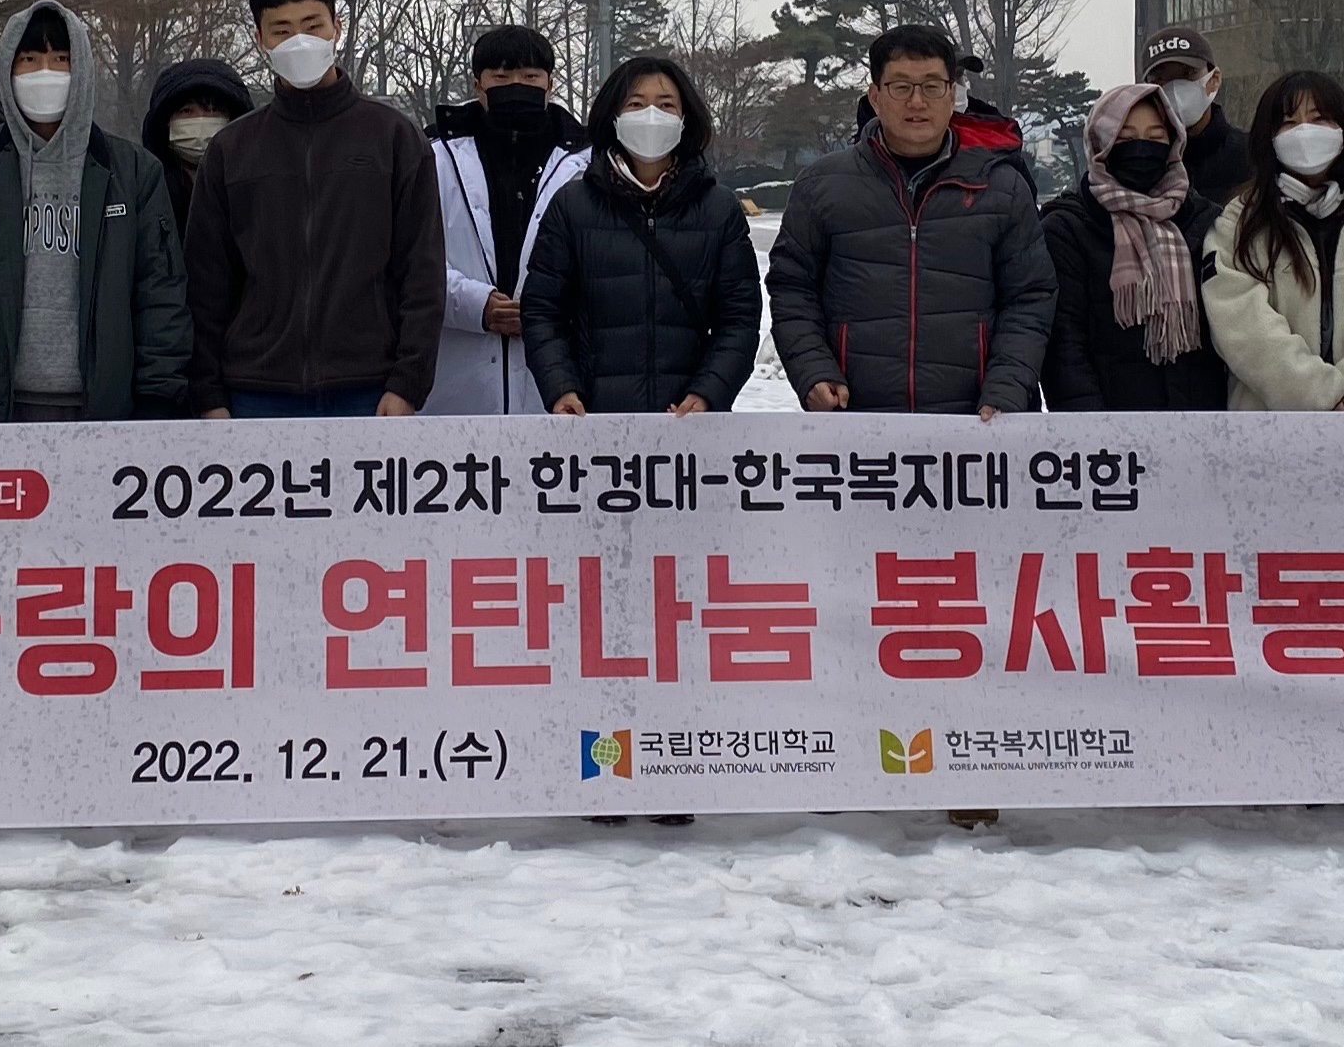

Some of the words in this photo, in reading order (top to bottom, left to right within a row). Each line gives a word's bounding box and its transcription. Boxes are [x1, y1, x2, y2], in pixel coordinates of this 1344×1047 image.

[113, 458, 331, 519] 2022년
[354, 453, 510, 515] 제2차
[530, 450, 1009, 514] 한경대-한국복지대
[1029, 449, 1145, 511] 연합
[321, 555, 818, 690] 연탄나눔
[132, 740, 252, 782] 2022.
[279, 738, 339, 780] 12.
[363, 730, 507, 781] 21.(수)
[638, 729, 836, 758] 국립한경대학교
[945, 729, 1133, 757] 한국복지대학교
[640, 763, 705, 775] HANKYONG
[708, 762, 767, 775] NATIONAL
[770, 761, 836, 774] UNIVERSITY
[948, 763, 979, 772] KOREA
[980, 762, 1026, 771] NATIONAL
[1027, 761, 1078, 771] UNIVERSITY
[1080, 761, 1092, 770] OF
[1094, 760, 1135, 769] WELFARE
